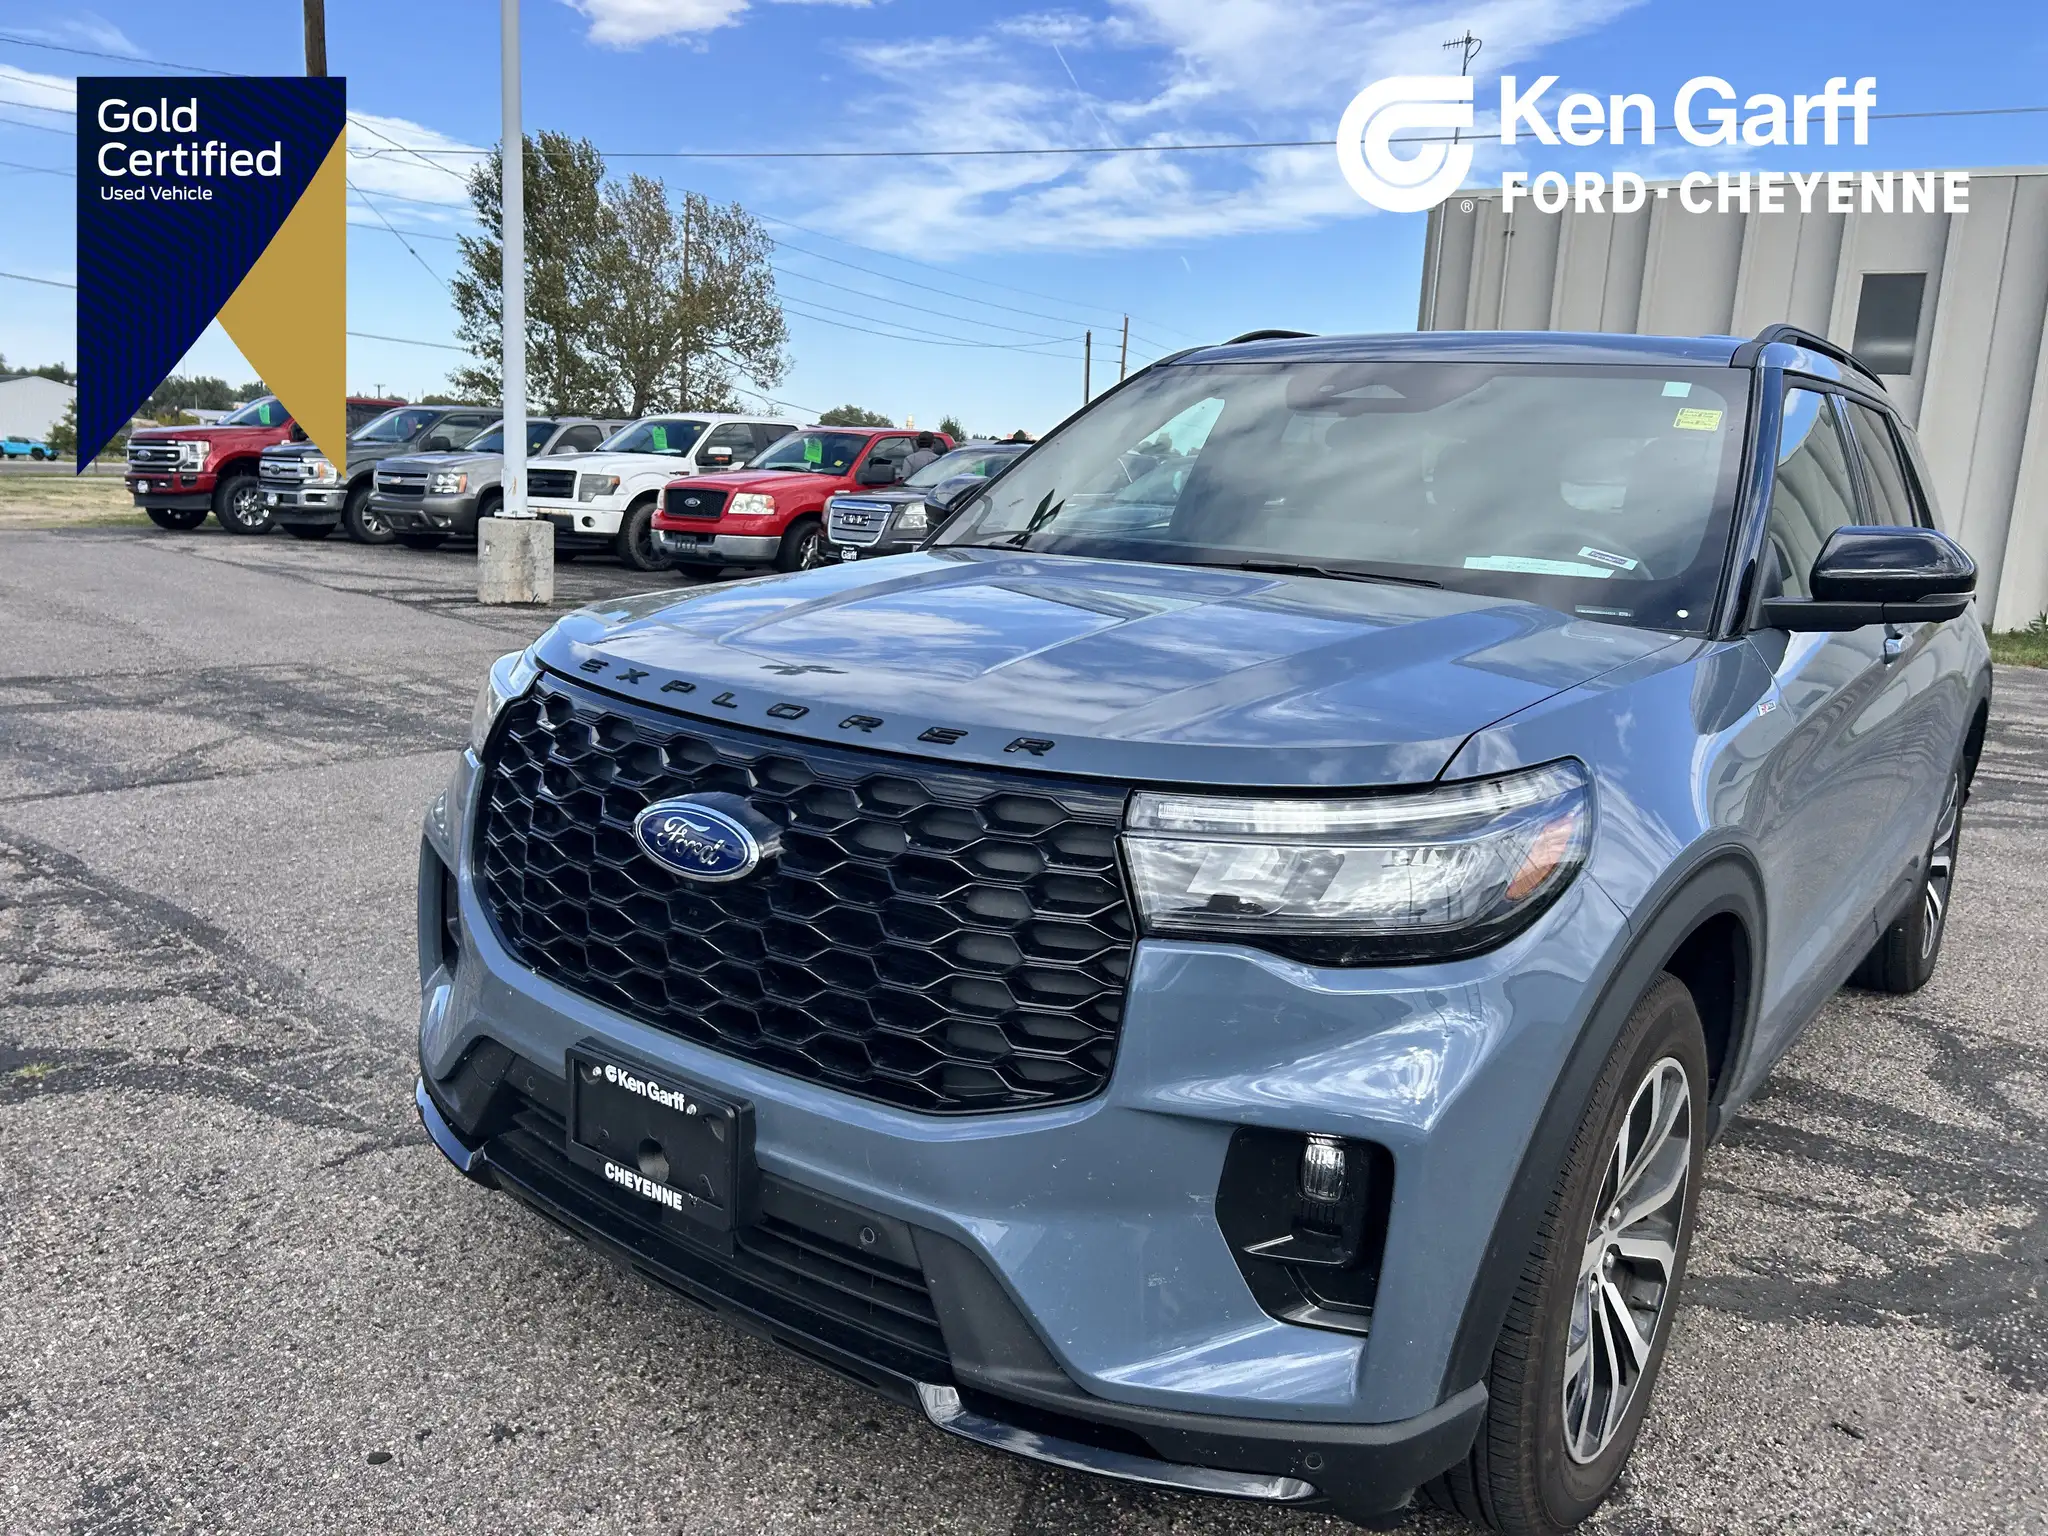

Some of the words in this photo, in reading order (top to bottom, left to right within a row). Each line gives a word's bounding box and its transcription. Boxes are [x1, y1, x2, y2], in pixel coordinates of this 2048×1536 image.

[579, 658, 1056, 757] EXPLORER
[656, 816, 726, 866] Ford
[616, 1068, 647, 1096] Ken
[647, 1081, 685, 1111] Garff
[604, 1162, 683, 1211] CHEYENNE
